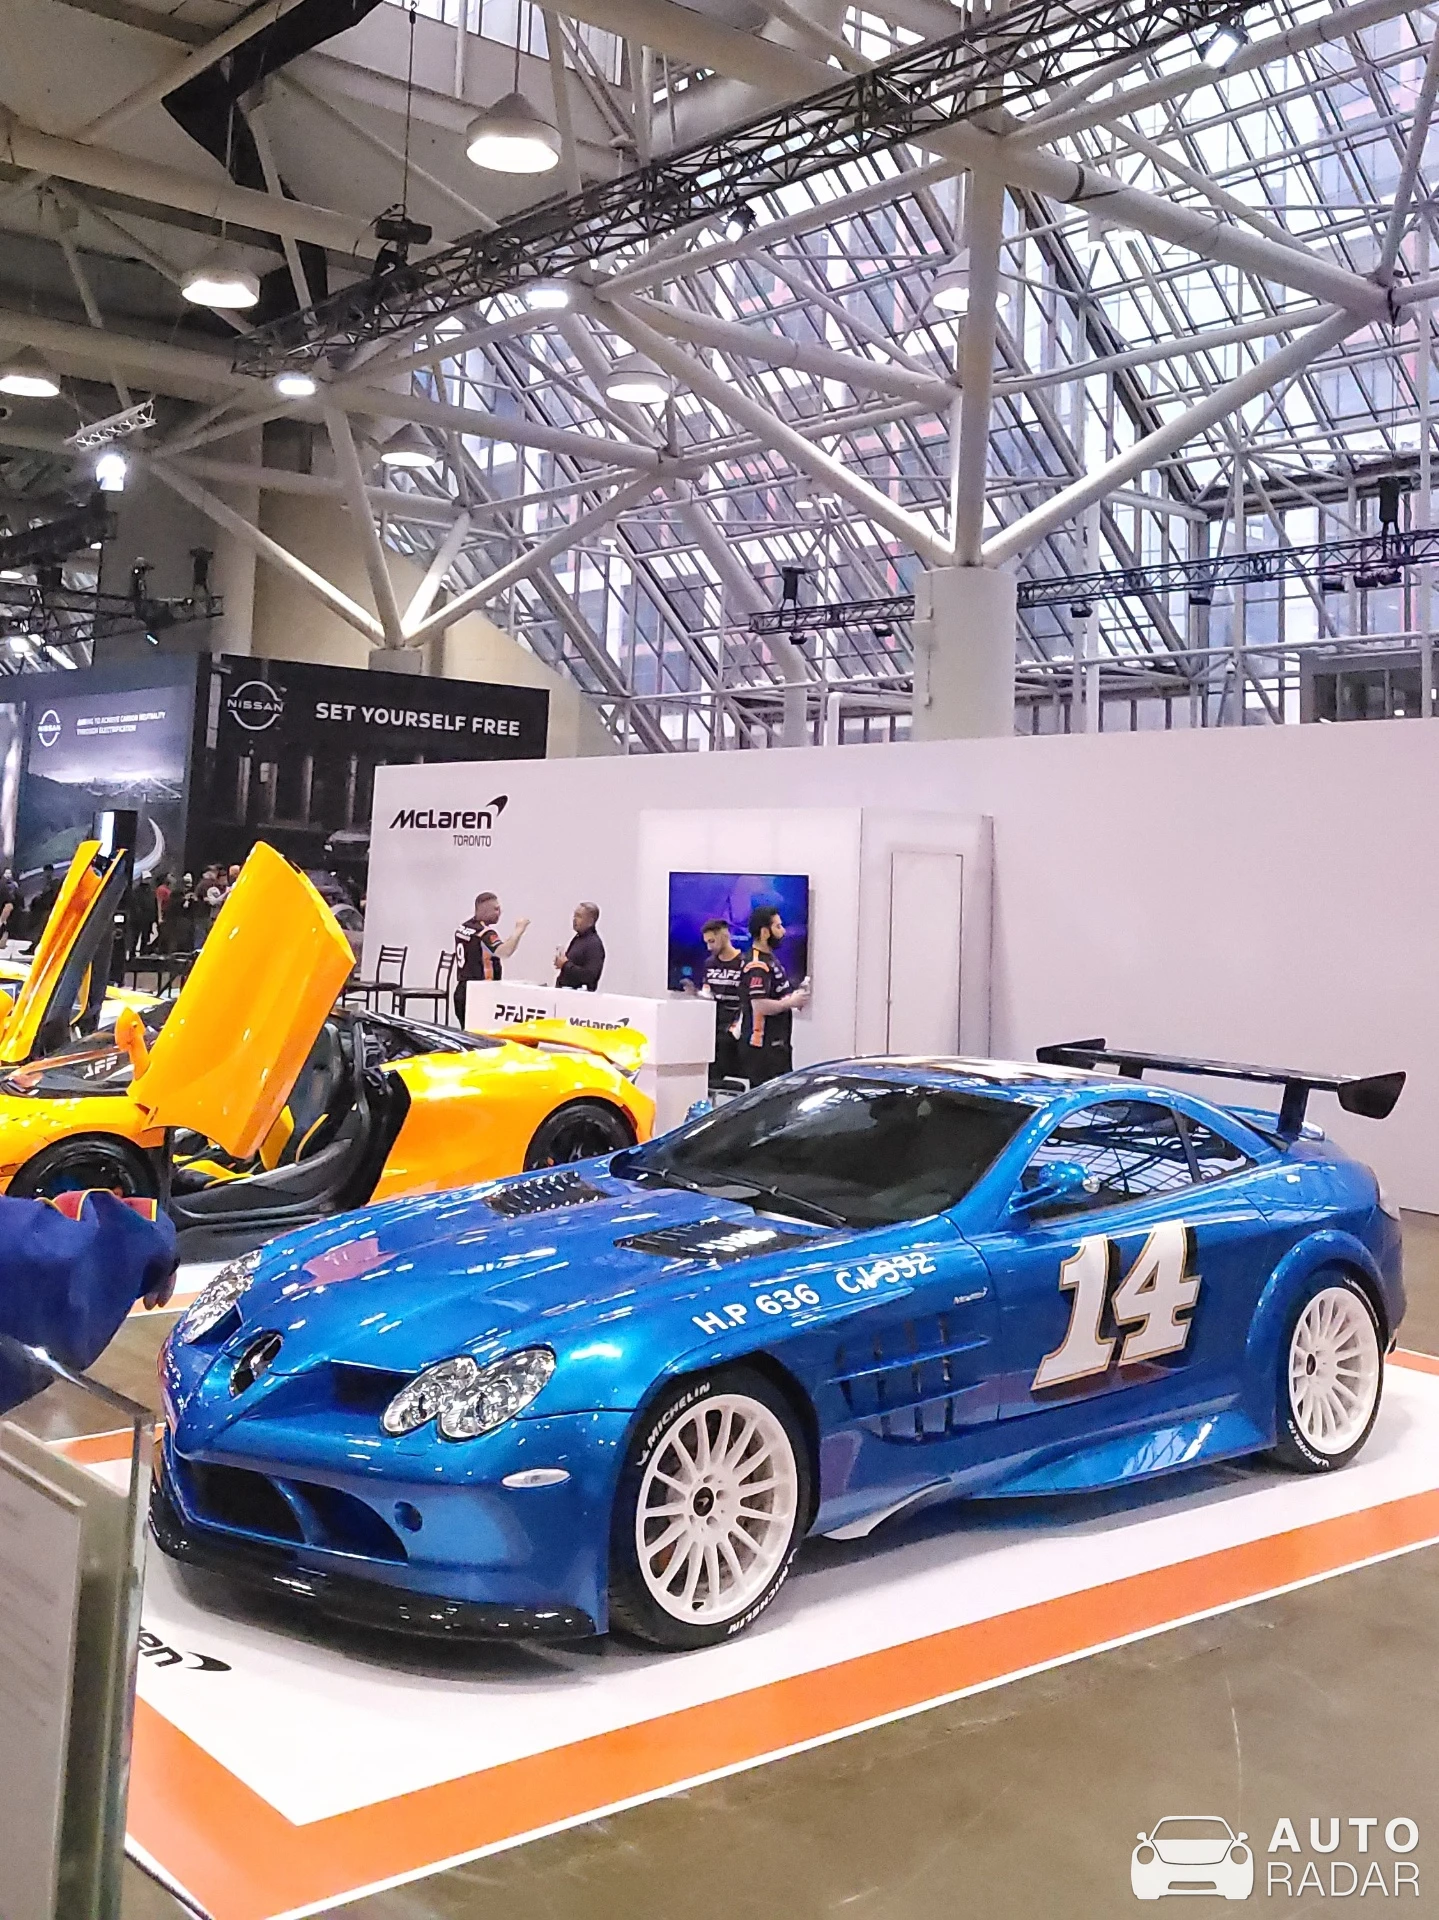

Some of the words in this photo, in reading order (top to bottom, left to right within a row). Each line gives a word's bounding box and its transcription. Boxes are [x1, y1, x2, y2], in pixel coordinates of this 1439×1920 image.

[227, 699, 284, 712] NISSAN
[315, 702, 356, 721] SET
[361, 706, 467, 731] YOURSELF
[472, 717, 520, 736] FREE
[388, 809, 492, 829] McLaren
[453, 834, 492, 847] TORONTO
[692, 1303, 748, 1335] H.P
[755, 1283, 820, 1316] 636
[1030, 1219, 1202, 1391] 14
[647, 1381, 712, 1449] MICHELIN
[727, 1565, 789, 1634] MICHELIN
